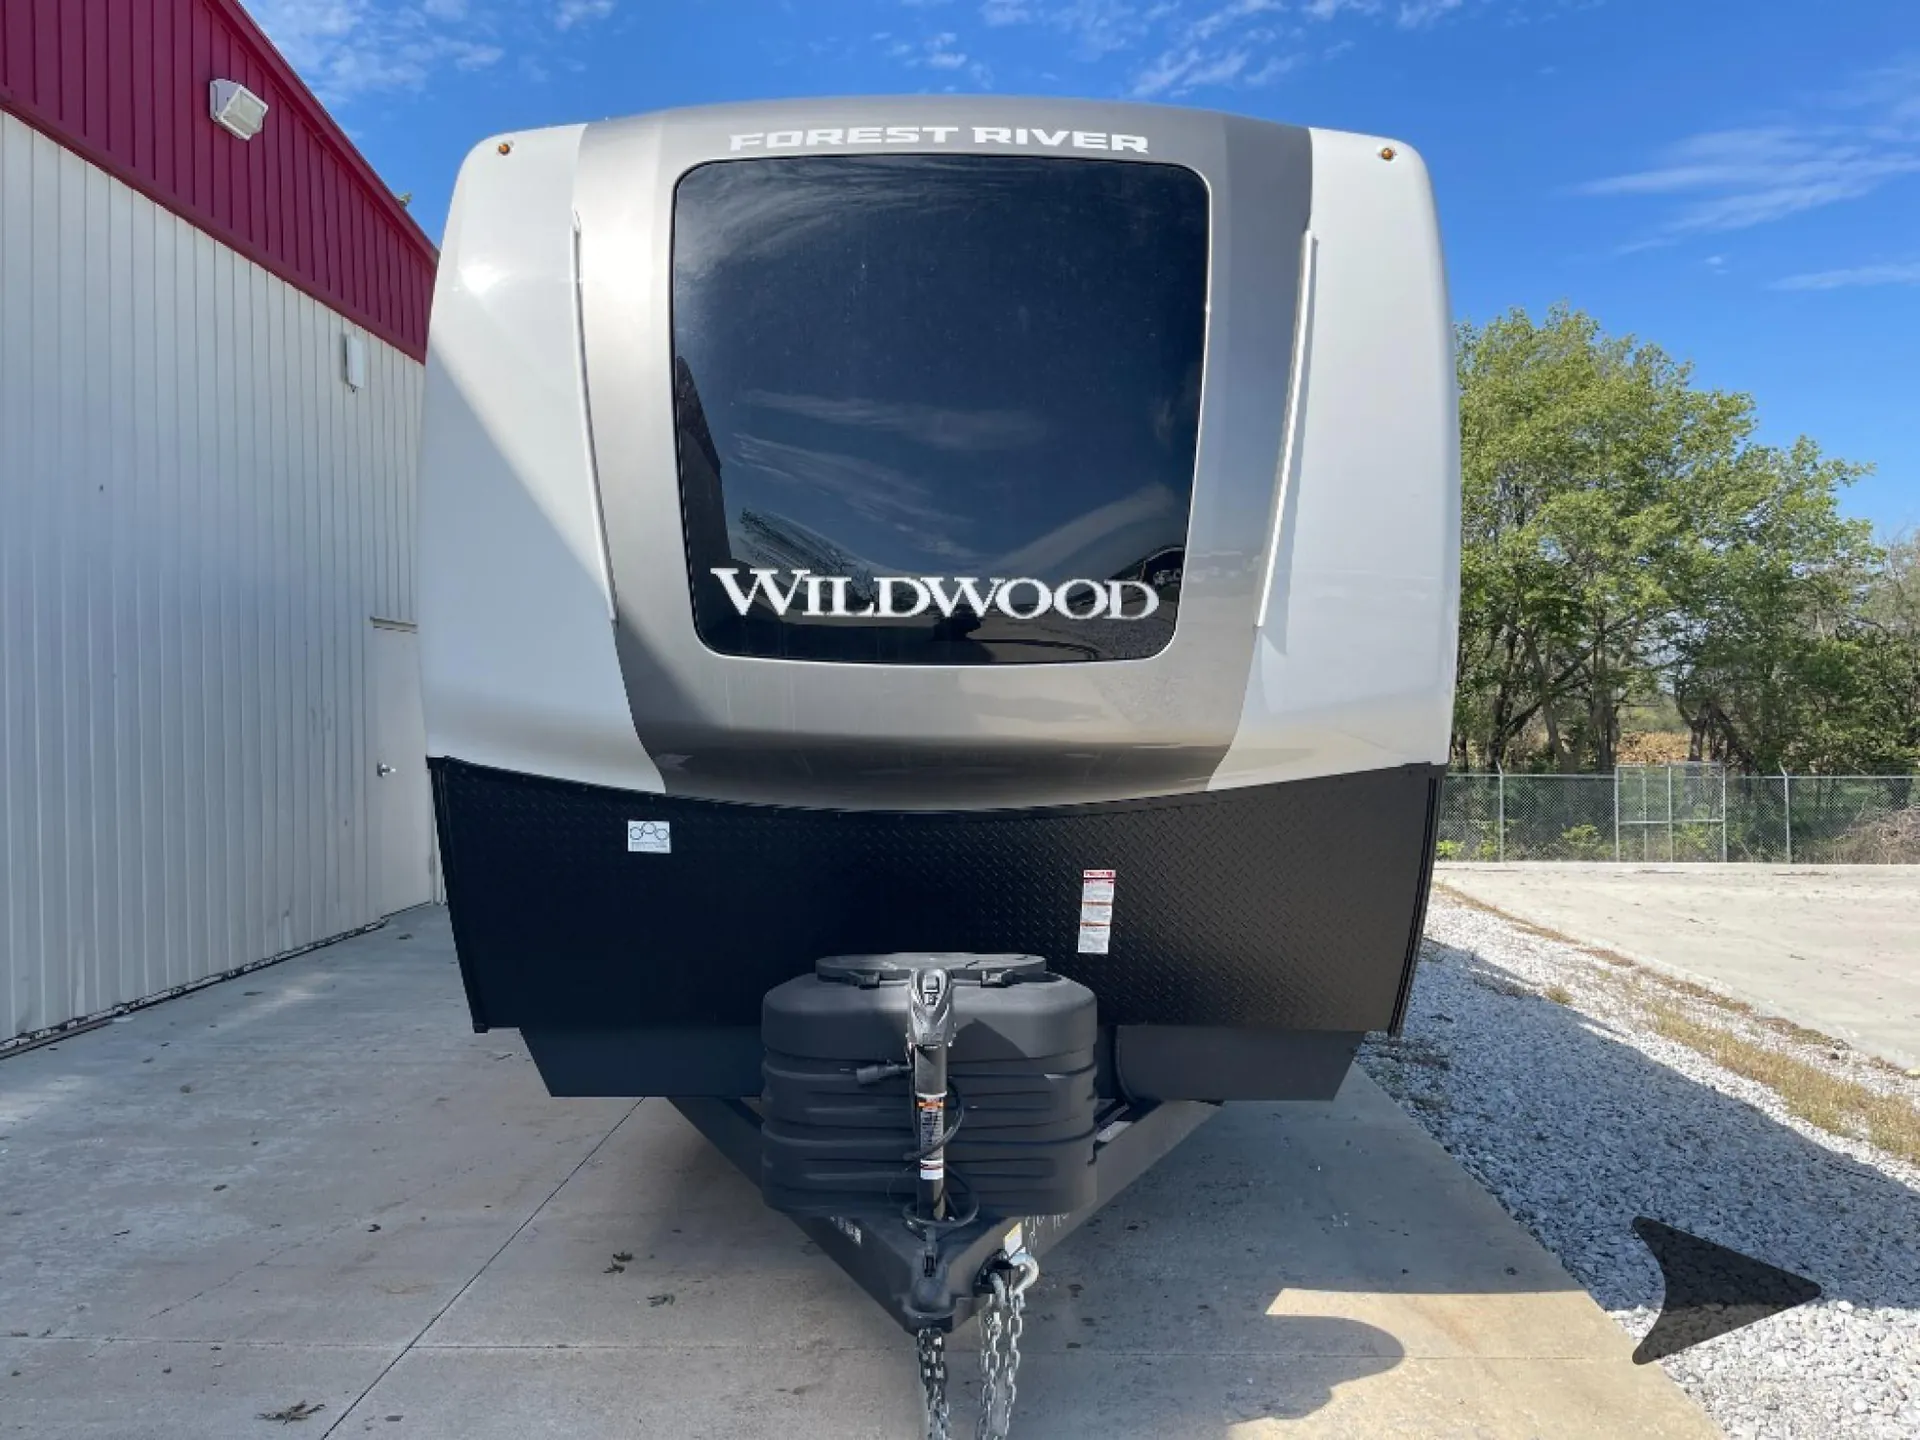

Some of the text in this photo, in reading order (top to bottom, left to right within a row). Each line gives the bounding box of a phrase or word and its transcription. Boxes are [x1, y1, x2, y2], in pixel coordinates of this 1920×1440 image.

[729, 127, 1150, 153] FOREST RIVER
[710, 568, 1159, 619] WILDWOOD
